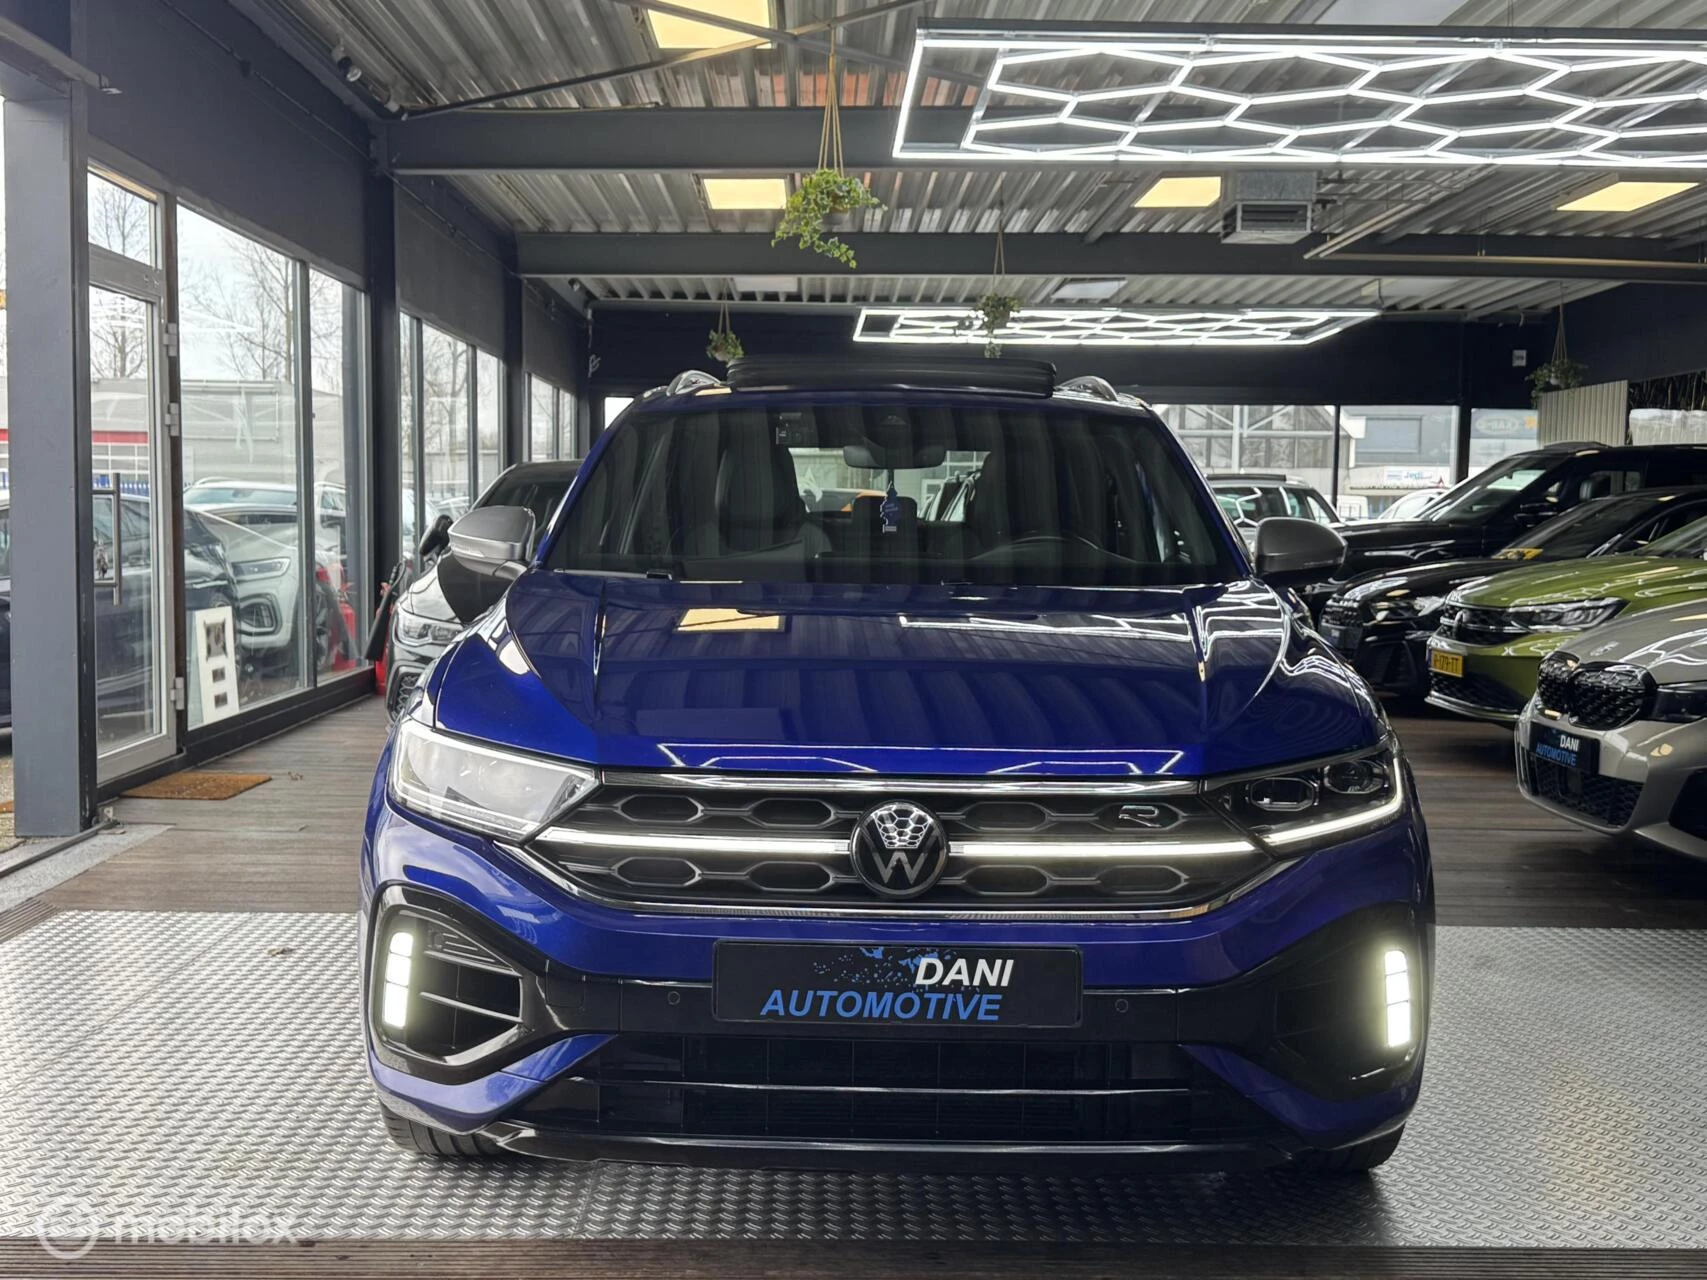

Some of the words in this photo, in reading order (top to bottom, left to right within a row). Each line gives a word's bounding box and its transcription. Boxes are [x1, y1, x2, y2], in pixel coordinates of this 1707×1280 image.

[1536, 743, 1577, 767] AUTOMOTIVE
[1560, 734, 1579, 752] DANI
[915, 958, 1014, 987] DANI
[760, 989, 1002, 1021] AUTOMOTIVE
